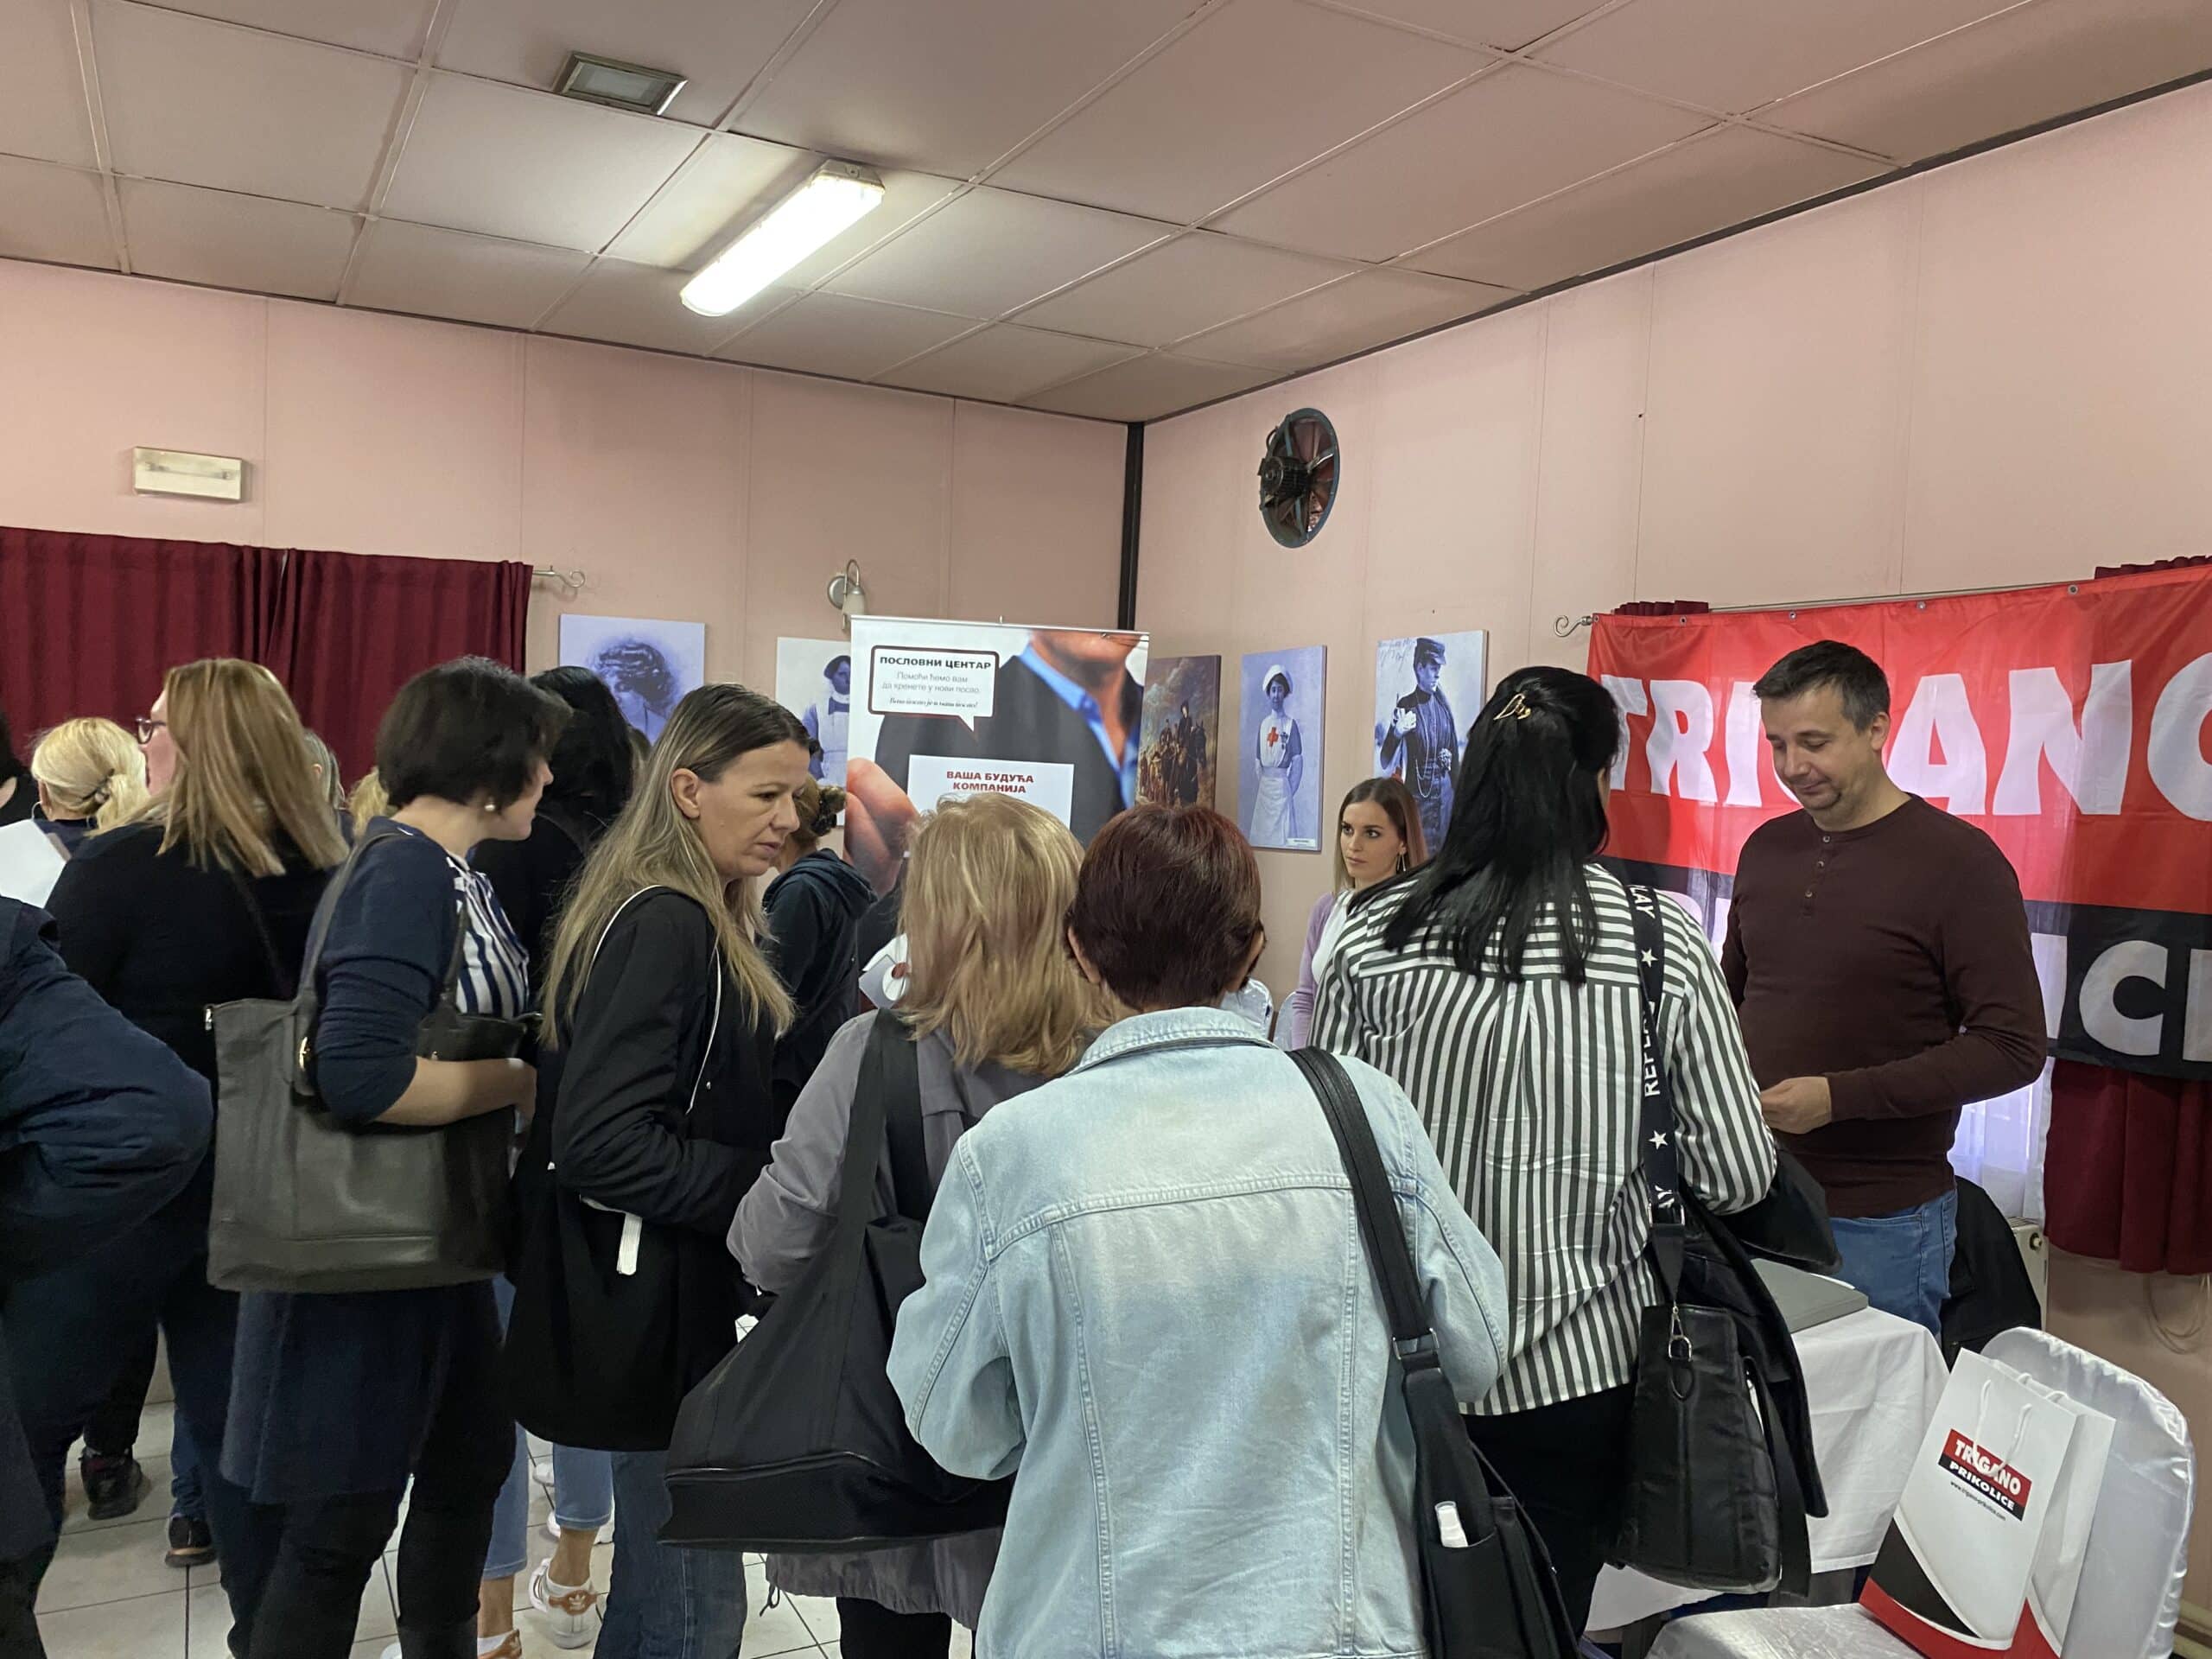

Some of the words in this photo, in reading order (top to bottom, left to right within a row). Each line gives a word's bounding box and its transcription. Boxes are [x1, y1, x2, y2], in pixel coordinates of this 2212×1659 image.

[880, 657, 942, 667] ПОСЛОВНИ
[945, 660, 991, 670] ЦЕНТАР
[947, 771, 982, 780] ВАША
[984, 772, 1034, 785] БУДУЋА
[953, 782, 1026, 794] КОМПАНИЈА
[1949, 1460, 2015, 1511] PRIKOLICE
